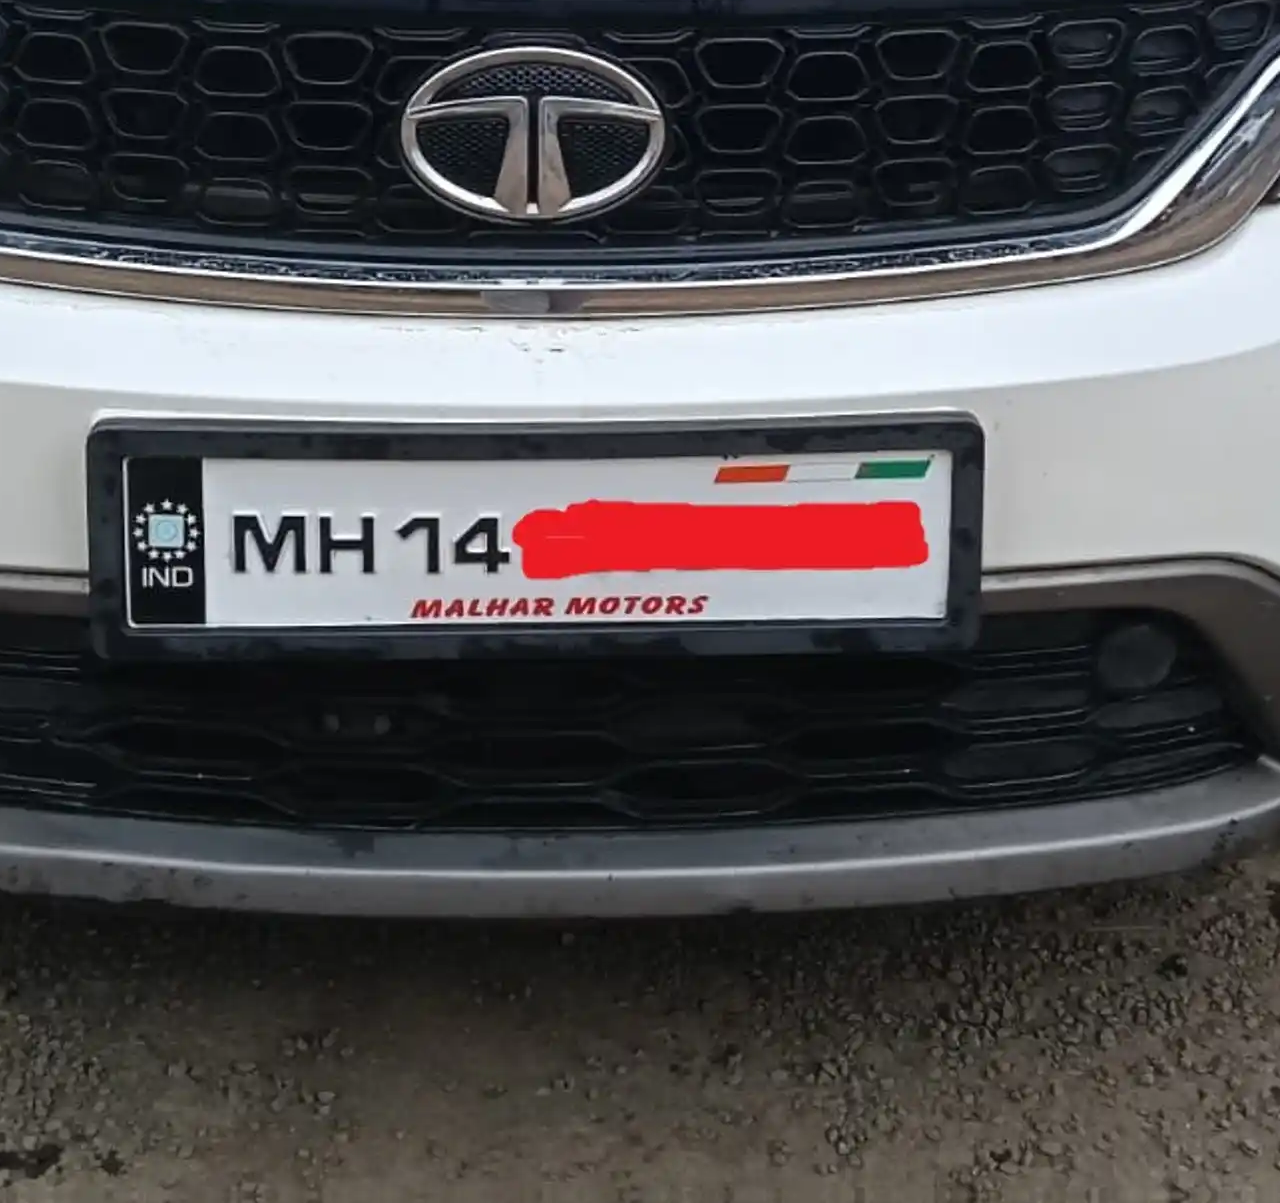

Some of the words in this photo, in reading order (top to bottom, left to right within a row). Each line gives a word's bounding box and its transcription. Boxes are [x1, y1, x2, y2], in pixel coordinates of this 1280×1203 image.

[141, 565, 195, 588] IND
[409, 597, 556, 619] MALHAR
[564, 594, 710, 616] MOTORS
